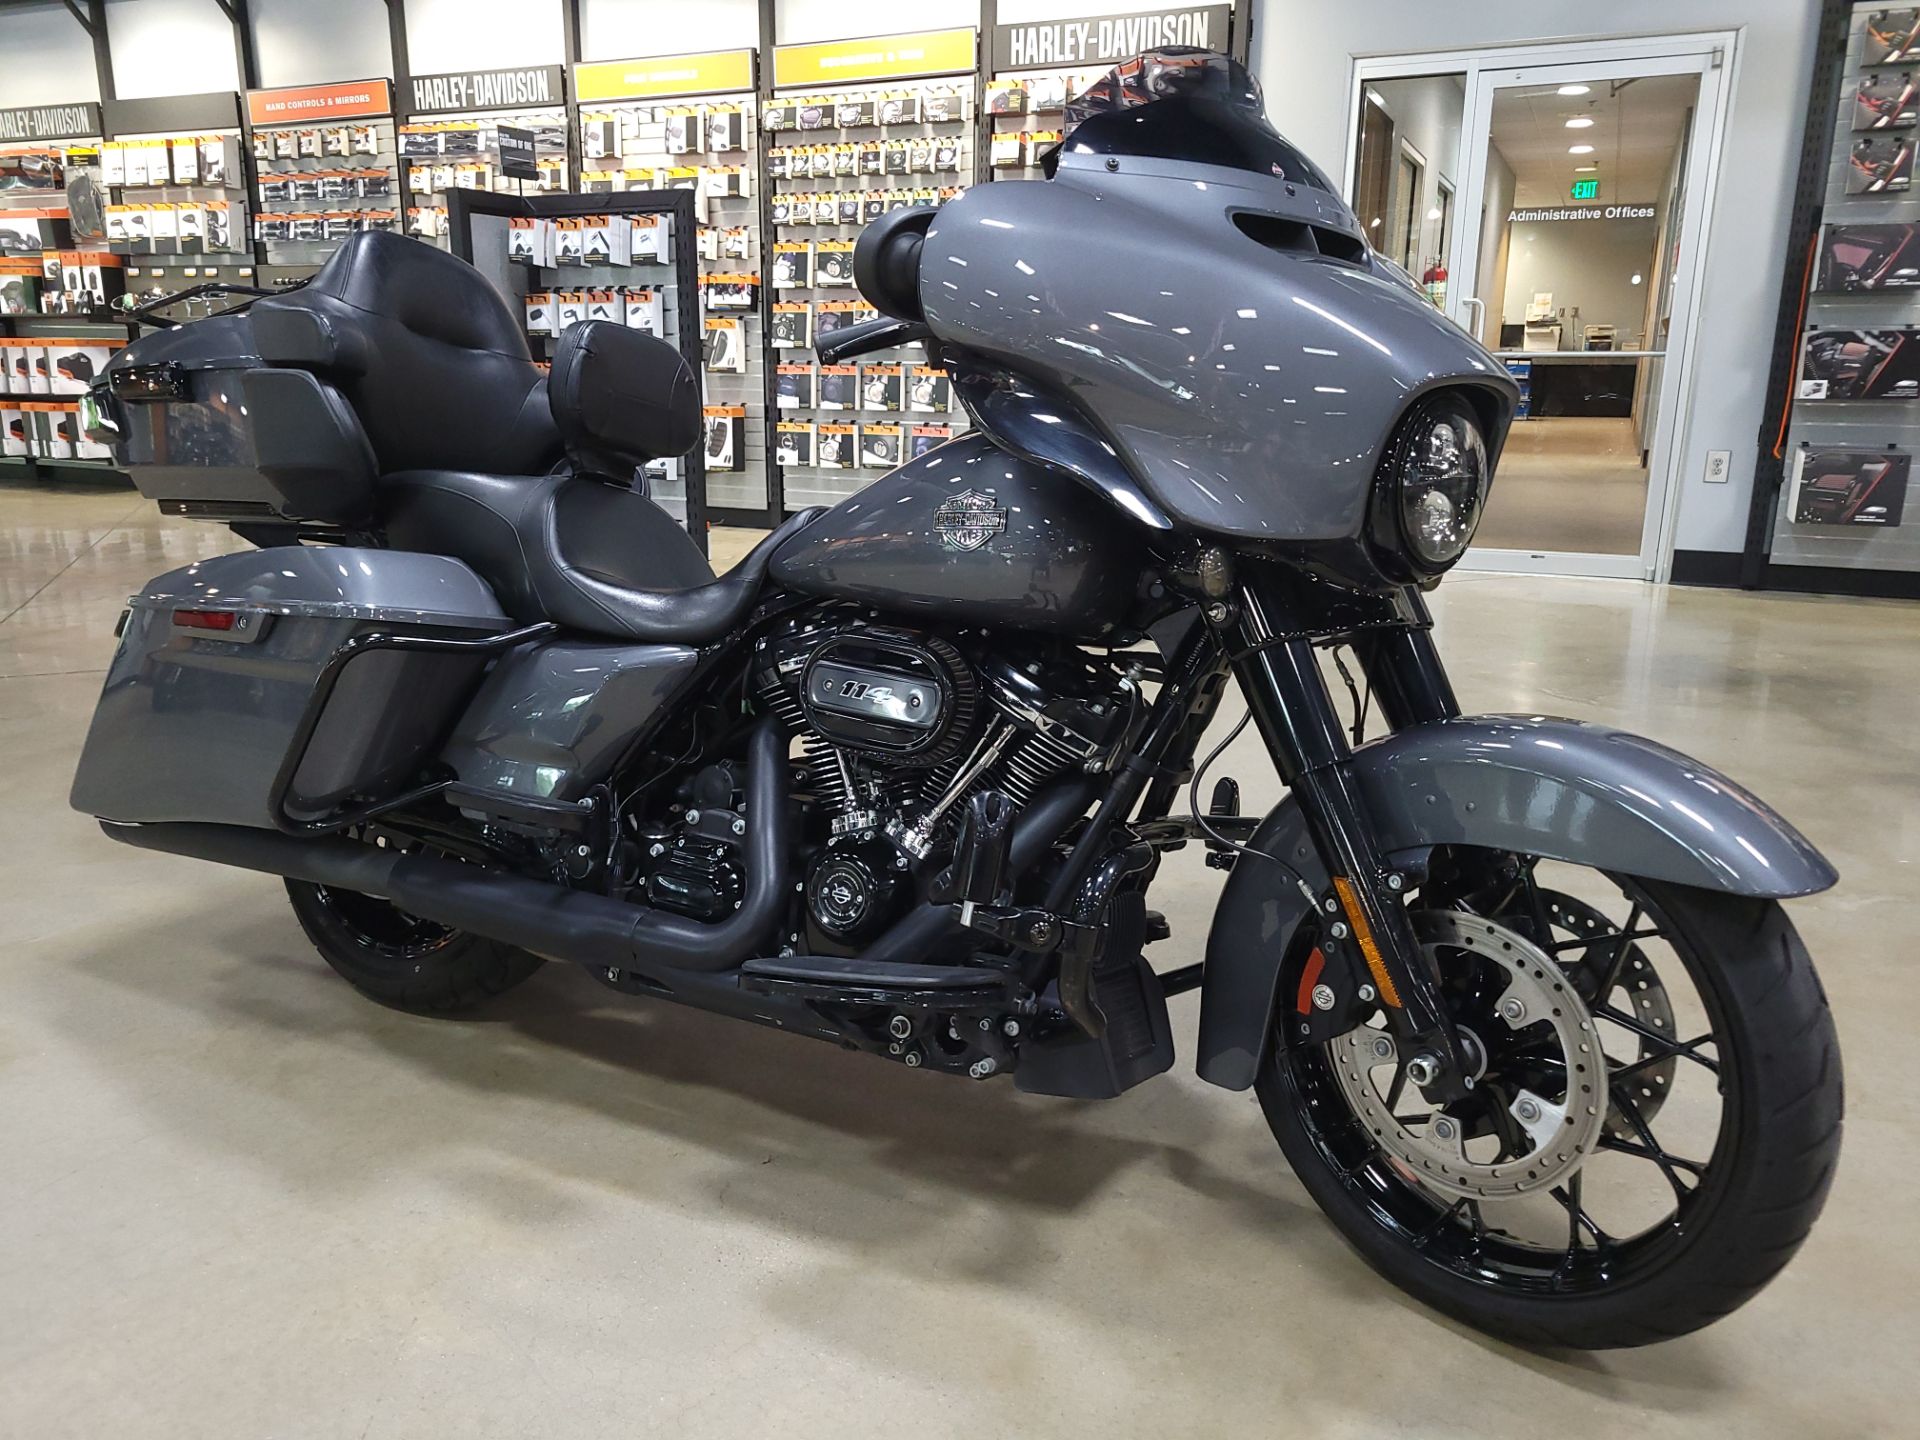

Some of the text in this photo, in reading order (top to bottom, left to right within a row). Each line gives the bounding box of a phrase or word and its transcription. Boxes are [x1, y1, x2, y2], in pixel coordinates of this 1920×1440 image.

[1010, 11, 1209, 65] HARLEY-DAVIDSON
[413, 70, 549, 110] HARLEY-DAVIDSON
[265, 94, 370, 112] HAND CONTROLS & MIRRORS
[0, 106, 90, 138] ARLEY-DAVIDSON
[1575, 181, 1598, 199] EXIT
[1507, 207, 1654, 222] Administrative Offices
[840, 680, 893, 704] 114
